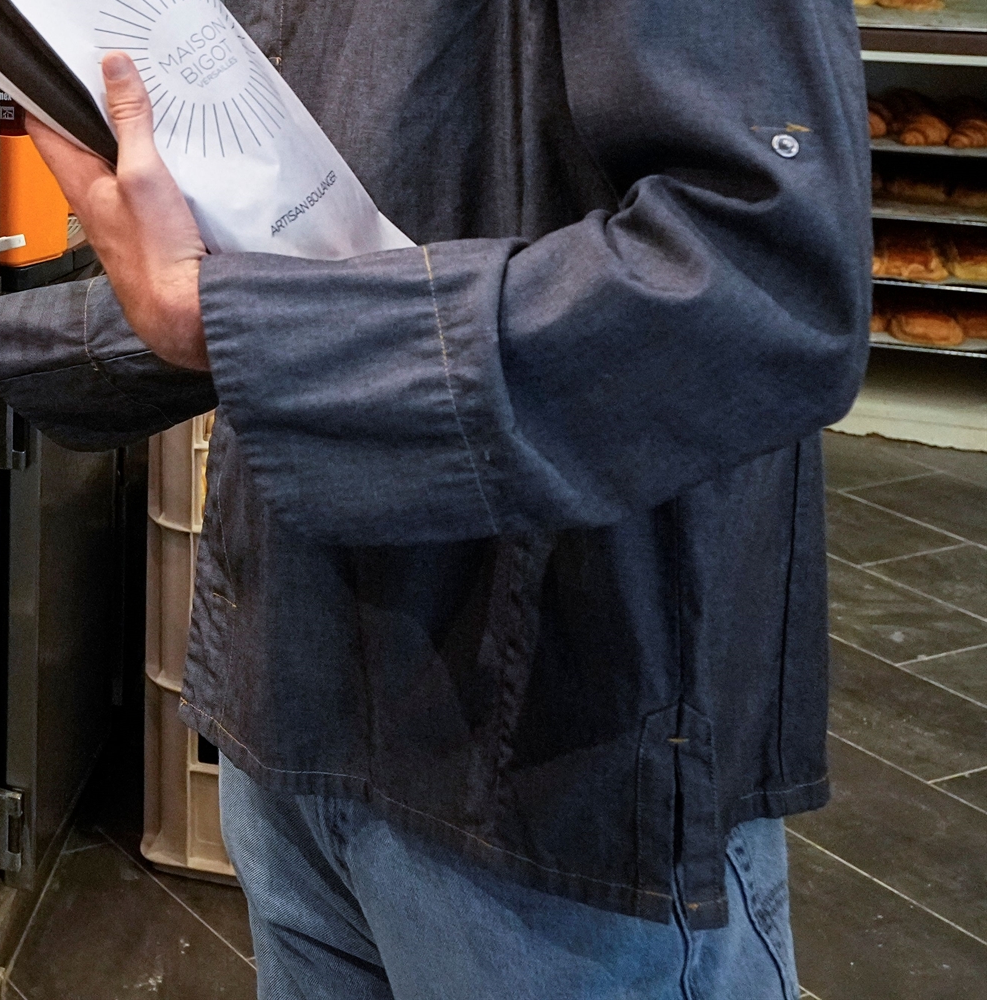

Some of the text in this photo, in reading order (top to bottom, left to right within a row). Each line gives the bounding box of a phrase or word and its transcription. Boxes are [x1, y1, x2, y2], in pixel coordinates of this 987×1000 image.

[158, 17, 226, 74] MAISON
[180, 38, 232, 84] BIGOT
[197, 56, 238, 88] VERSAILLES
[271, 170, 338, 238] ARTISAN BOULANGER
